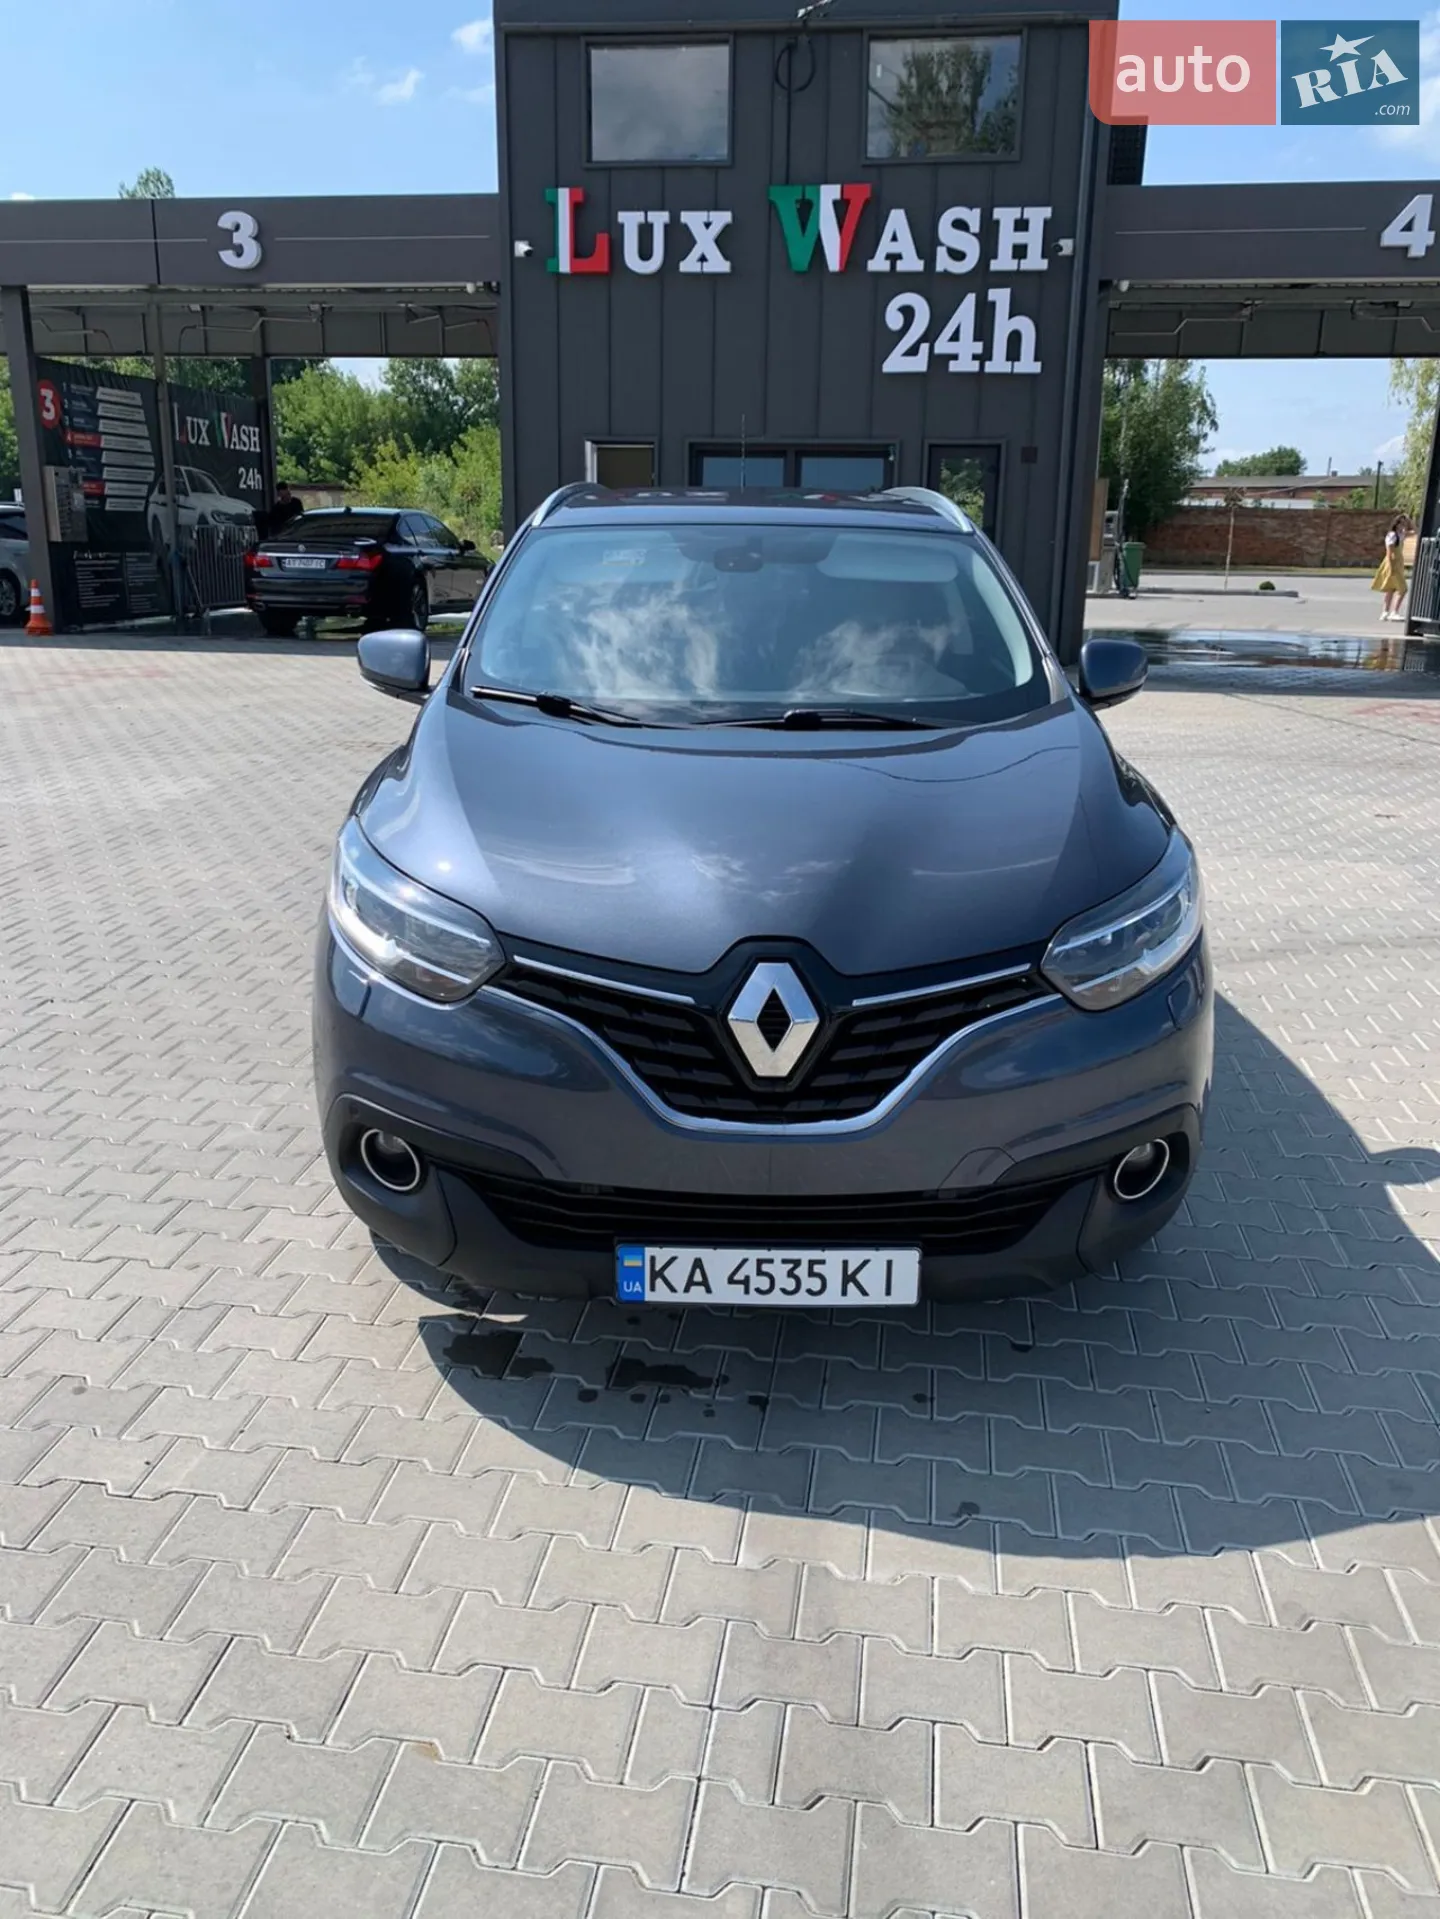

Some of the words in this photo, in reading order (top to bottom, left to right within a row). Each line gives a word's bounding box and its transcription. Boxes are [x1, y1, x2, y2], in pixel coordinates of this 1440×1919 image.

[217, 210, 262, 269] 3
[545, 186, 733, 275] LUX
[768, 183, 1053, 275] WASH
[1380, 193, 1436, 258] 4
[882, 287, 1042, 373] 24h
[40, 388, 55, 420] 3
[238, 466, 263, 491] 24h
[623, 1281, 643, 1293] UA
[649, 1255, 713, 1294] KA
[727, 1257, 829, 1297] 4535
[841, 1258, 894, 1297] KI
